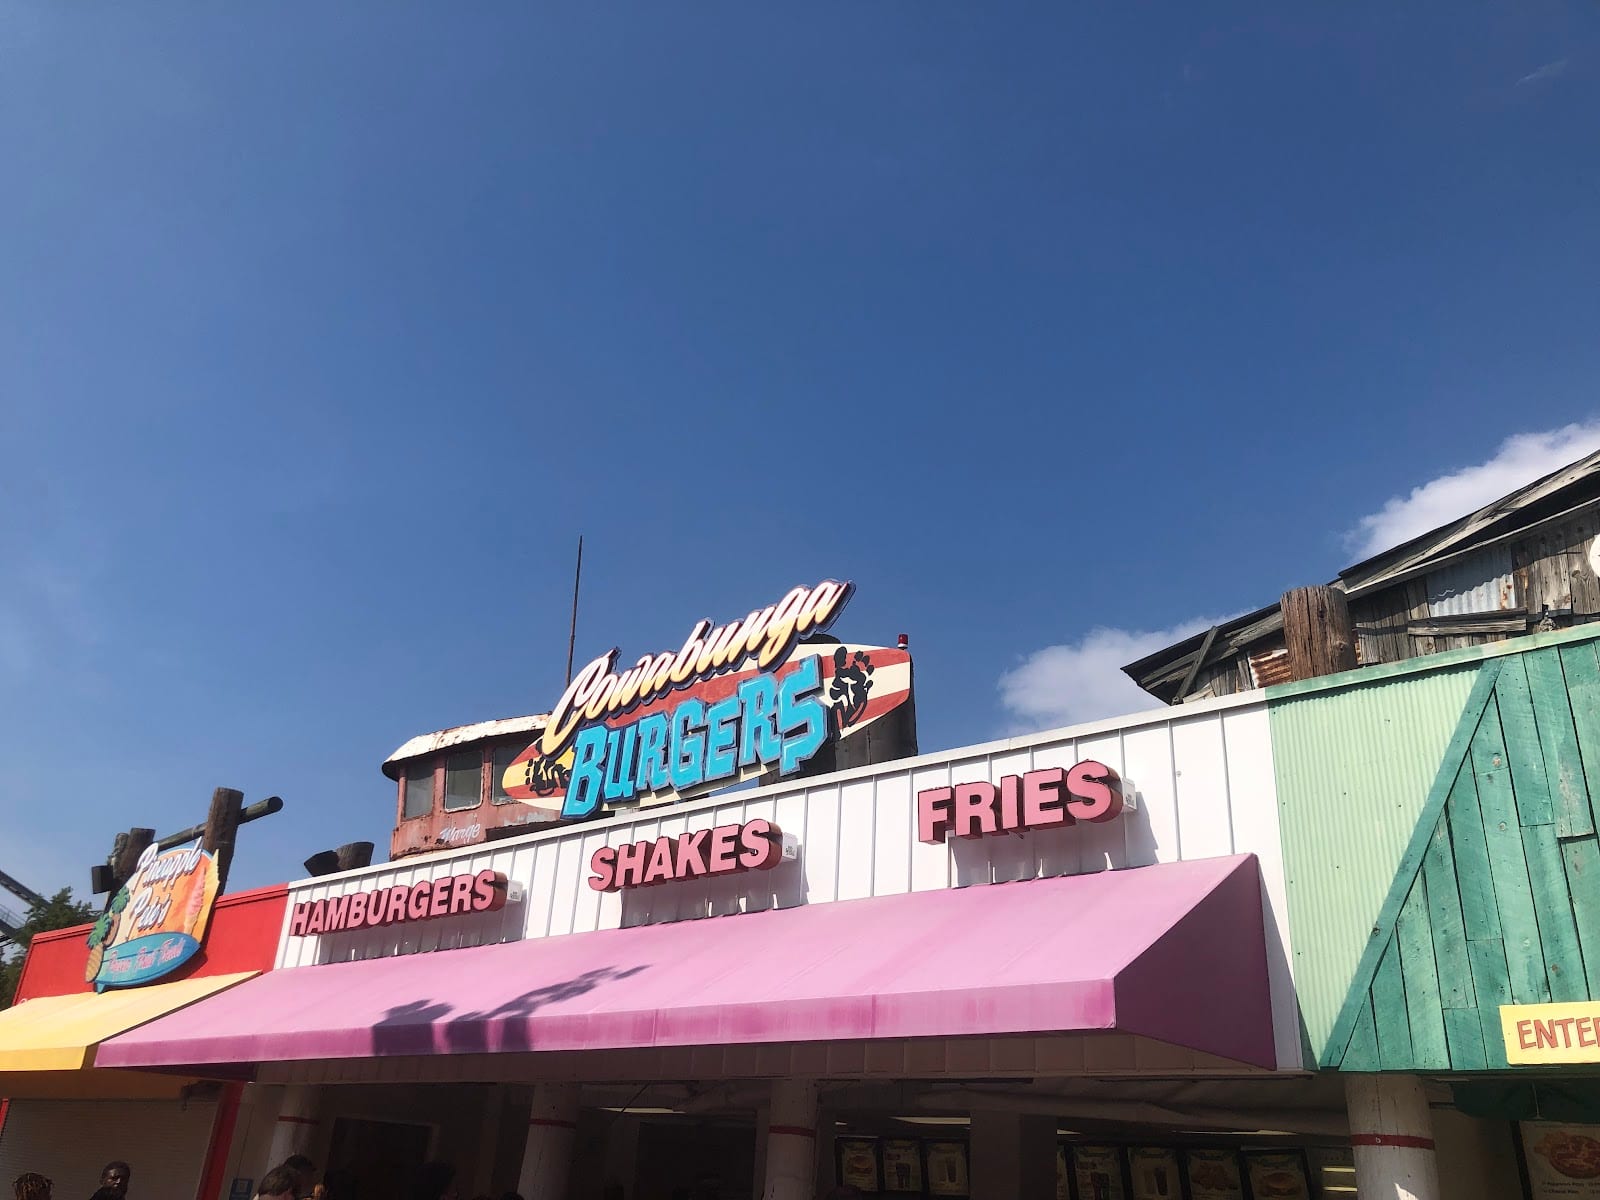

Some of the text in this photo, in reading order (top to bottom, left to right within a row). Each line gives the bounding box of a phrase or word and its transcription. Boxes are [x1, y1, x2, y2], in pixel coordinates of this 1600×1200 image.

[541, 580, 853, 756] Cowabunga
[561, 654, 829, 819] BURGERS
[917, 759, 1113, 843] FRIES
[588, 818, 772, 892] SHAKES
[289, 869, 499, 937] HAMBURGERS
